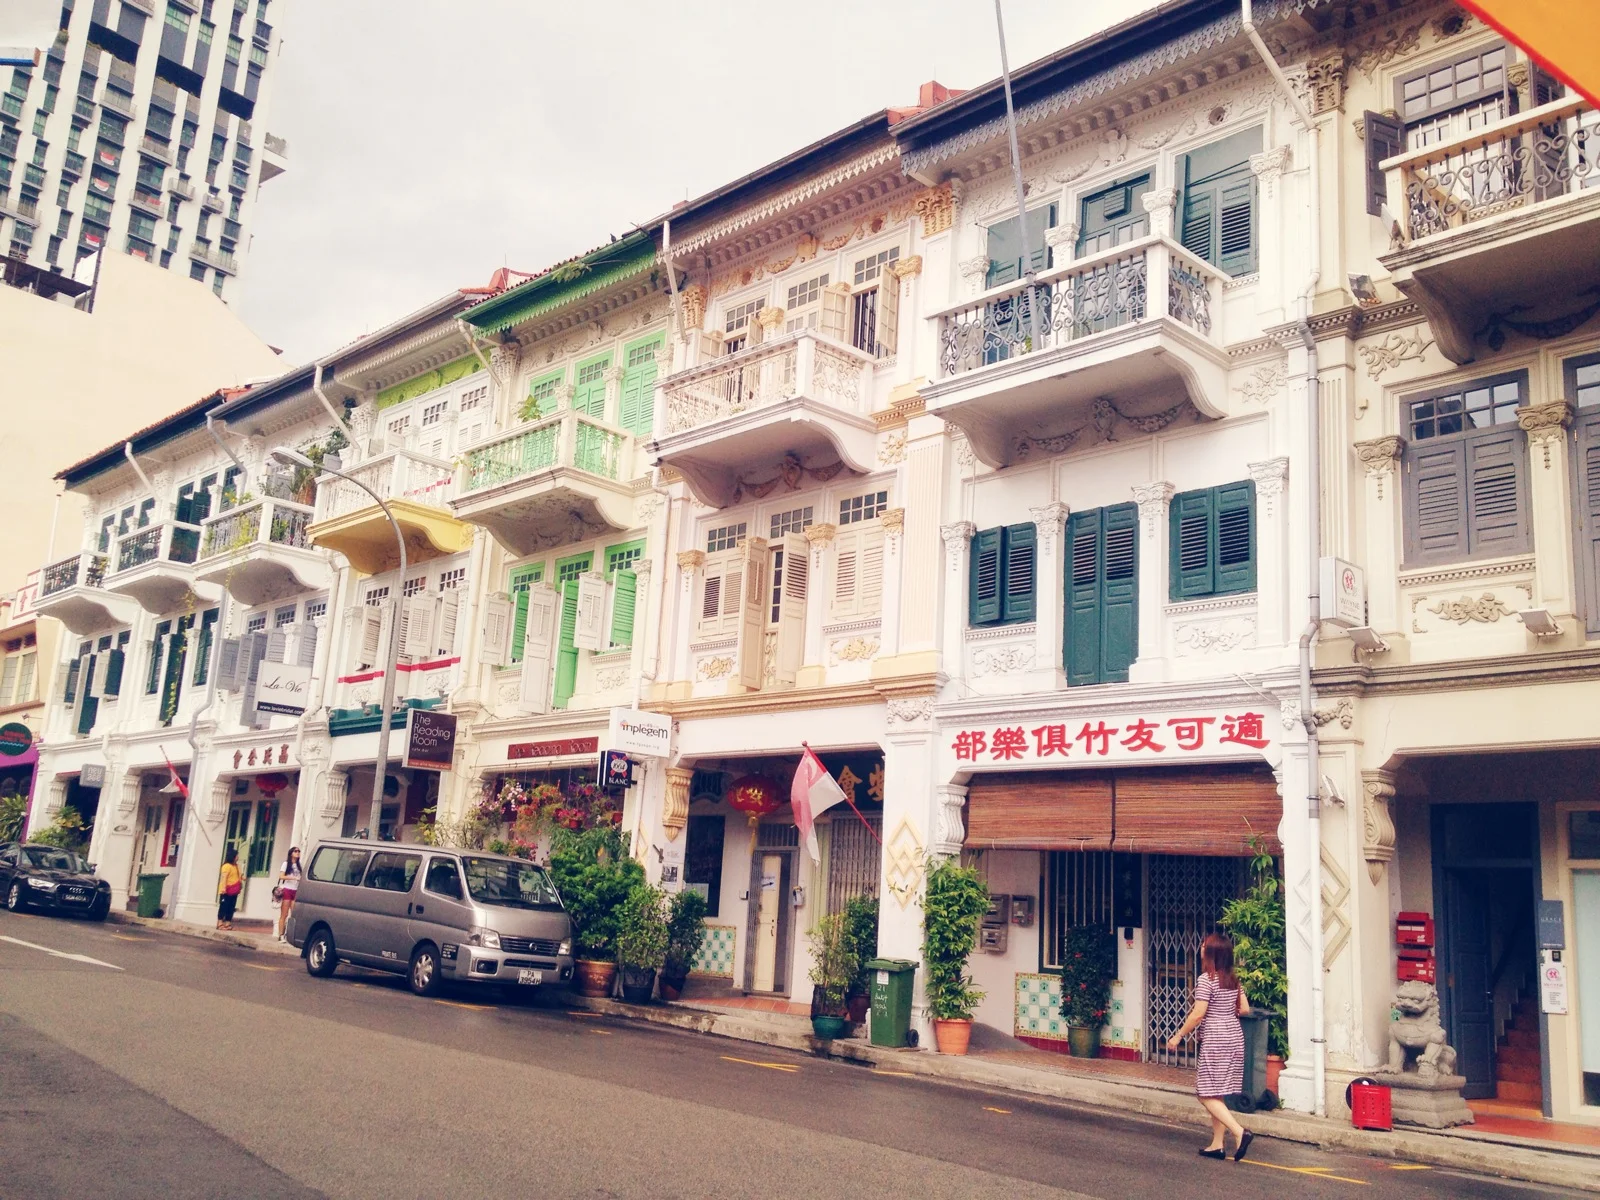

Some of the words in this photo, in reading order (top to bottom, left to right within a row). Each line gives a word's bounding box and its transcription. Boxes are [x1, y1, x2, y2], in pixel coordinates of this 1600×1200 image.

[415, 712, 431, 725] The
[414, 723, 451, 740] Reading
[412, 733, 438, 747] Room
[608, 776, 629, 785] BLANC
